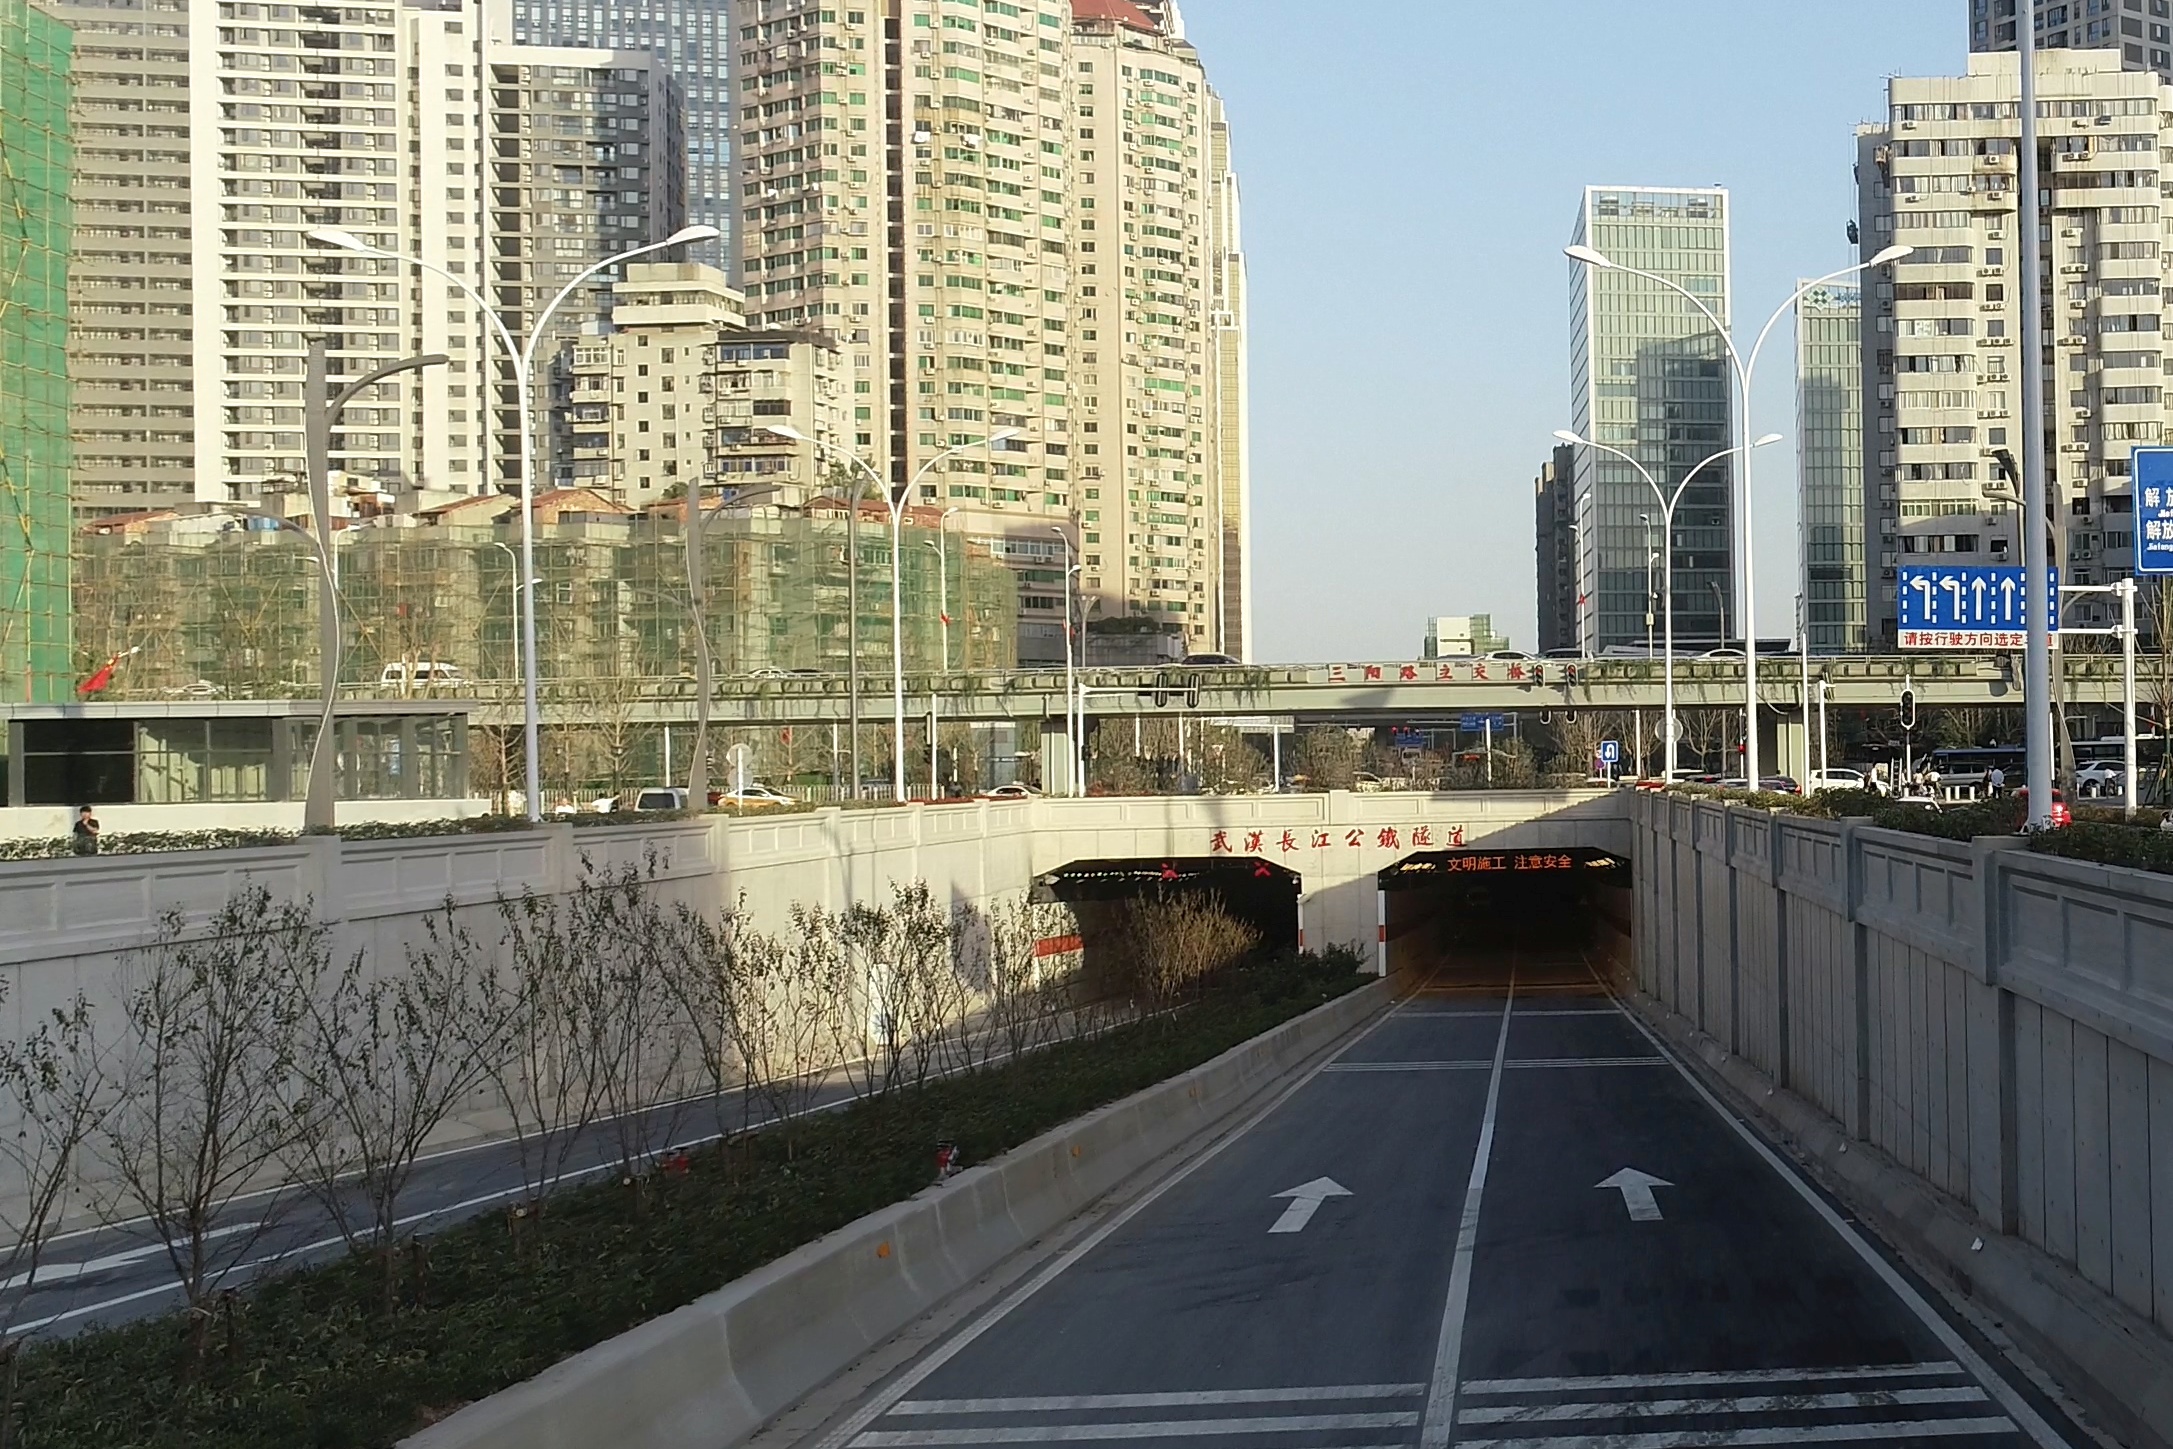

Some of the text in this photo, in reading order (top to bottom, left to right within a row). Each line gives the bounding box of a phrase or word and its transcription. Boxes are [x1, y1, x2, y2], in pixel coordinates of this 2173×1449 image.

[1904, 632, 2053, 647] 请按行驶方向选定
[1447, 854, 1572, 871] 文明施工 注意安全
